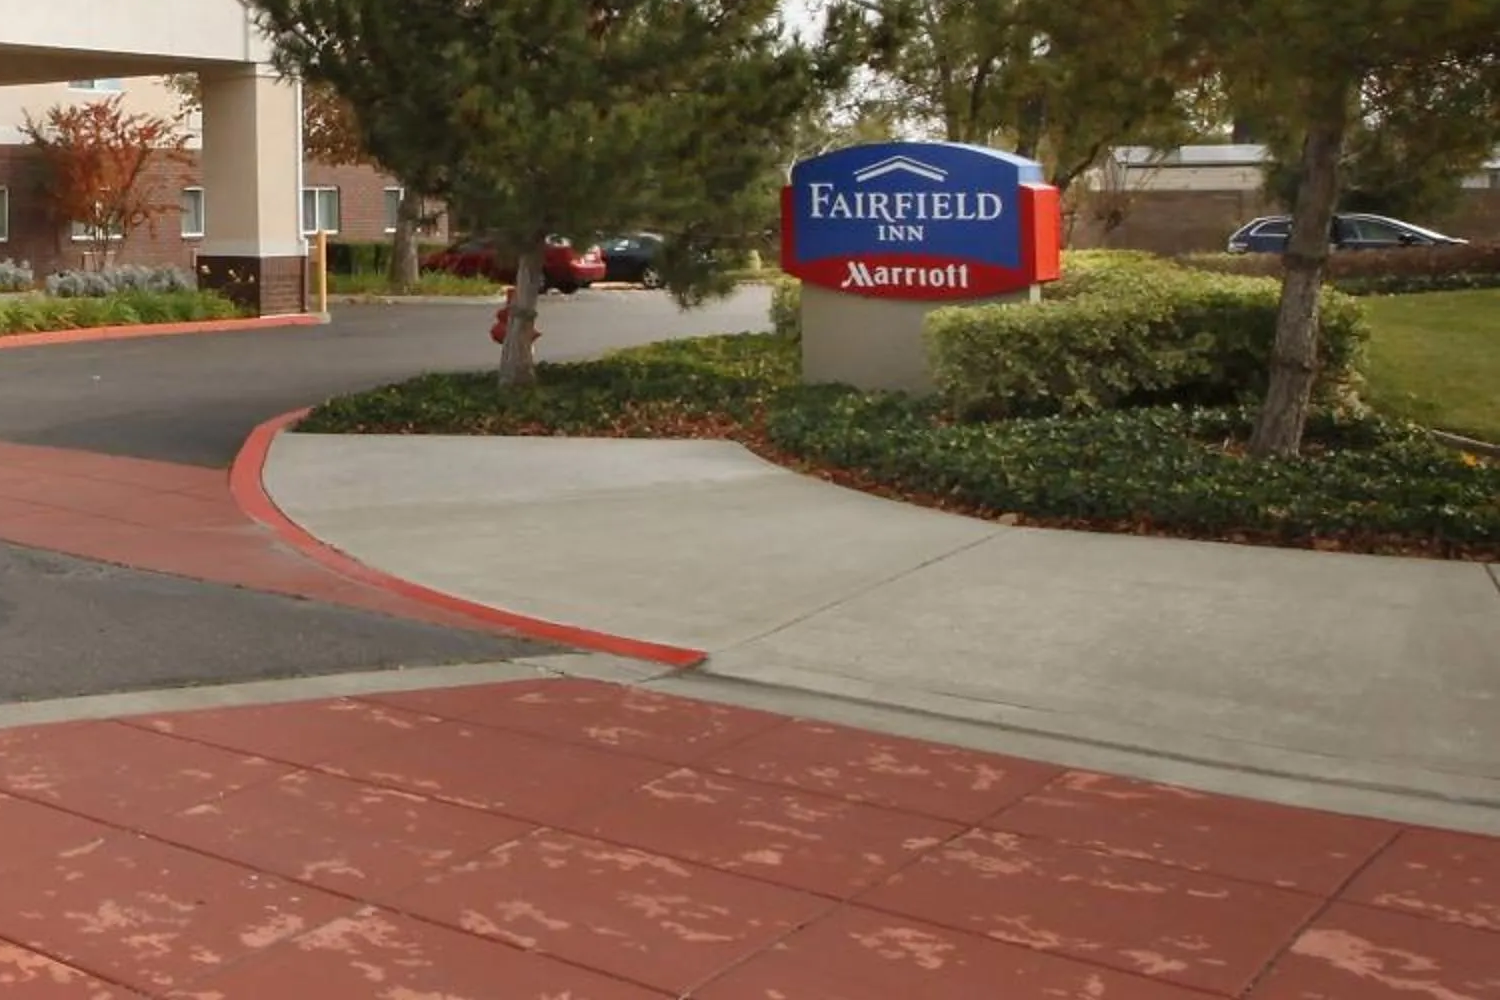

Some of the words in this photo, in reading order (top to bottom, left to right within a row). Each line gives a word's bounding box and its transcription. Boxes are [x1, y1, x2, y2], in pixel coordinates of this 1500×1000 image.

[809, 183, 1003, 222] FAIRFIELD
[878, 225, 924, 241] INN
[841, 262, 969, 288] Marriott
